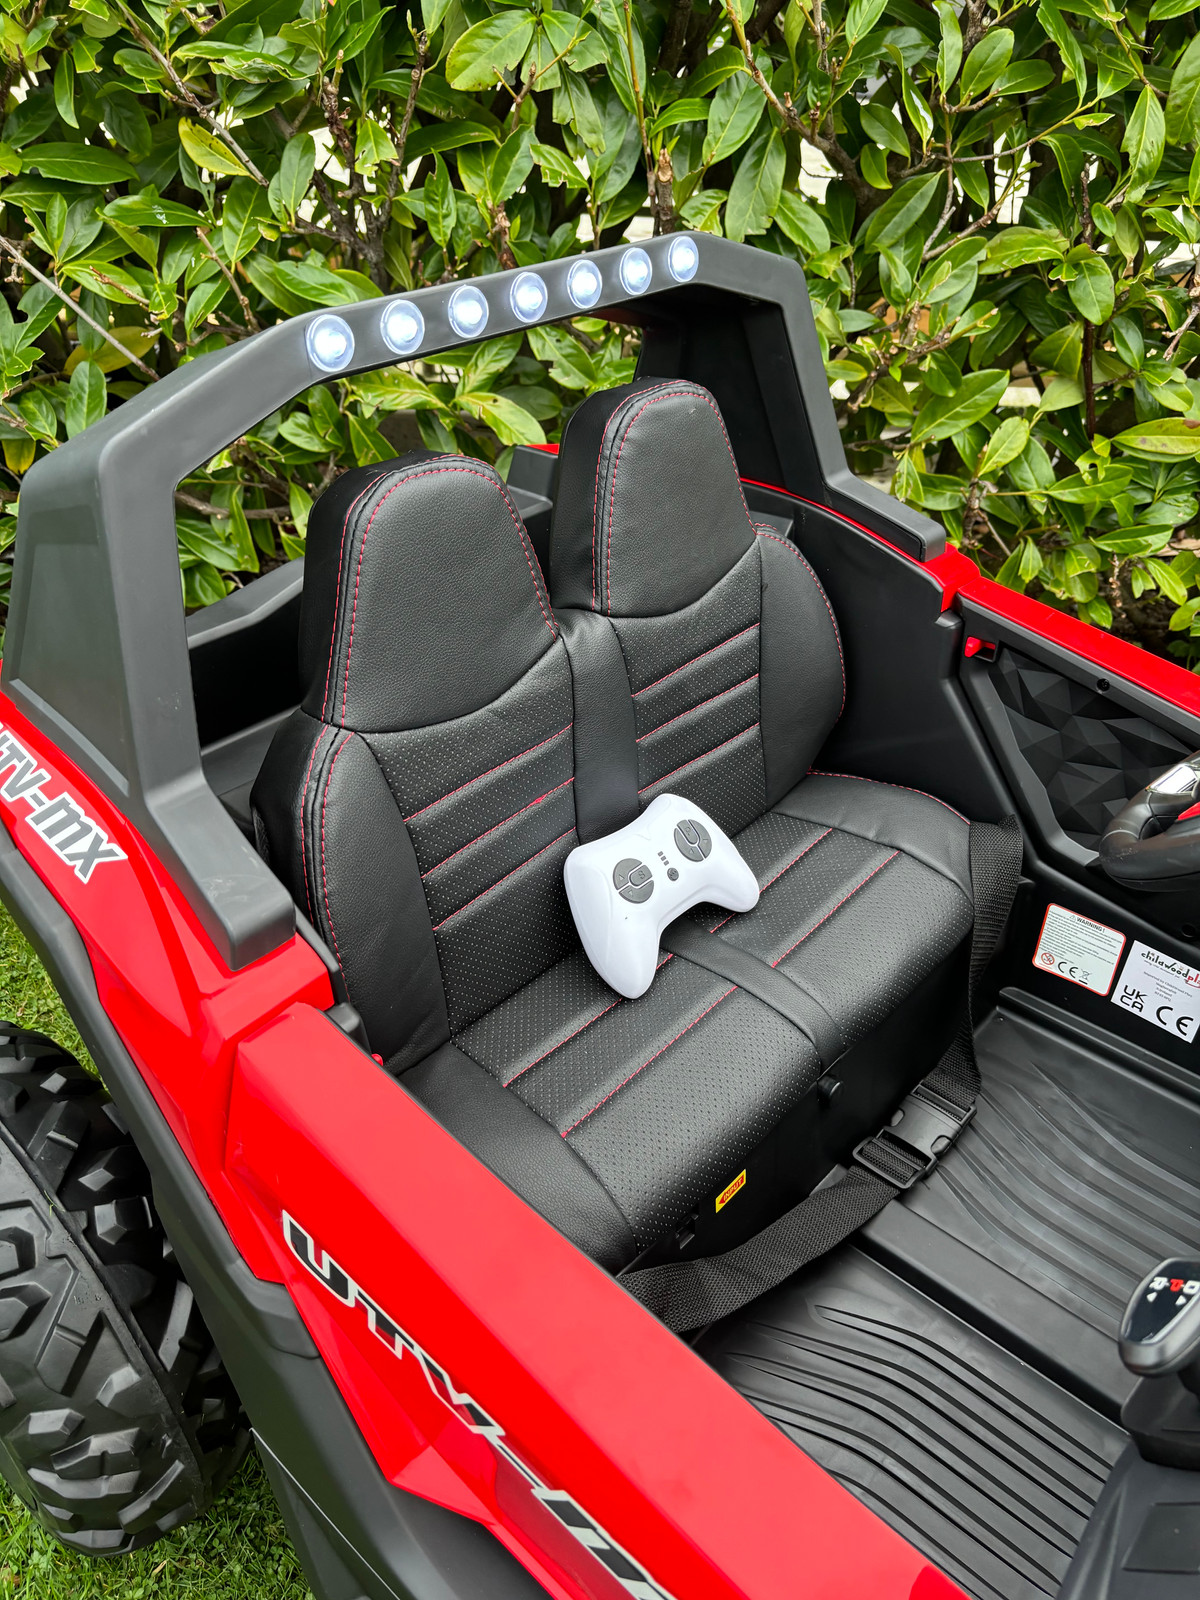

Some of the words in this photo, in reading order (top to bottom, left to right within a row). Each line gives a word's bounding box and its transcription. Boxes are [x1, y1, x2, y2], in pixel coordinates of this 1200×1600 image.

[1057, 961, 1079, 979] CE
[1120, 994, 1144, 1013] CA
[1124, 984, 1148, 1004] UK
[1156, 1005, 1194, 1037] CE
[723, 1177, 743, 1201] INPUT
